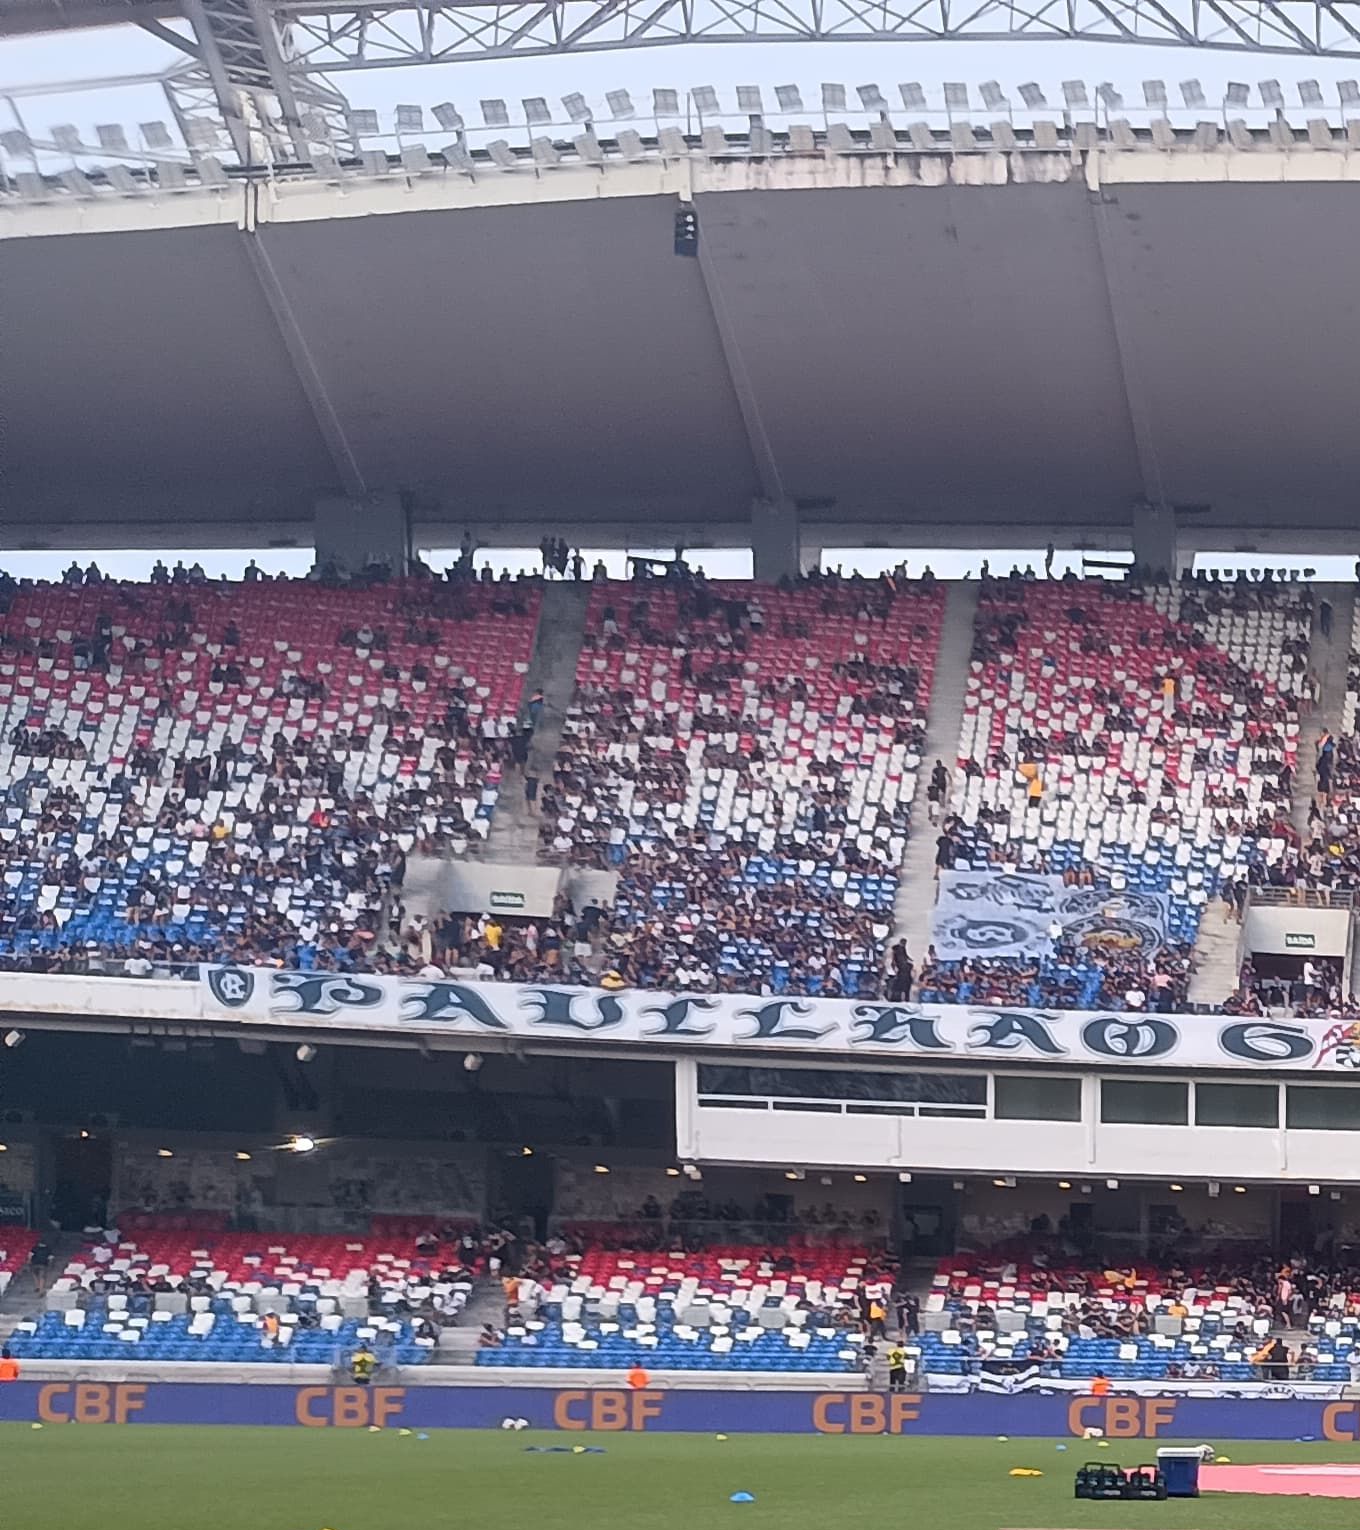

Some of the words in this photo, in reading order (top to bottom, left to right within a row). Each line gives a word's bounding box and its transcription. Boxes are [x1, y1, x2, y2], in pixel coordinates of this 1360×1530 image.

[38, 1384, 149, 1424] CBF
[296, 1386, 407, 1427] CBF
[554, 1390, 664, 1431] CBF
[813, 1393, 922, 1434] CBF
[1067, 1396, 1177, 1438] CBF
